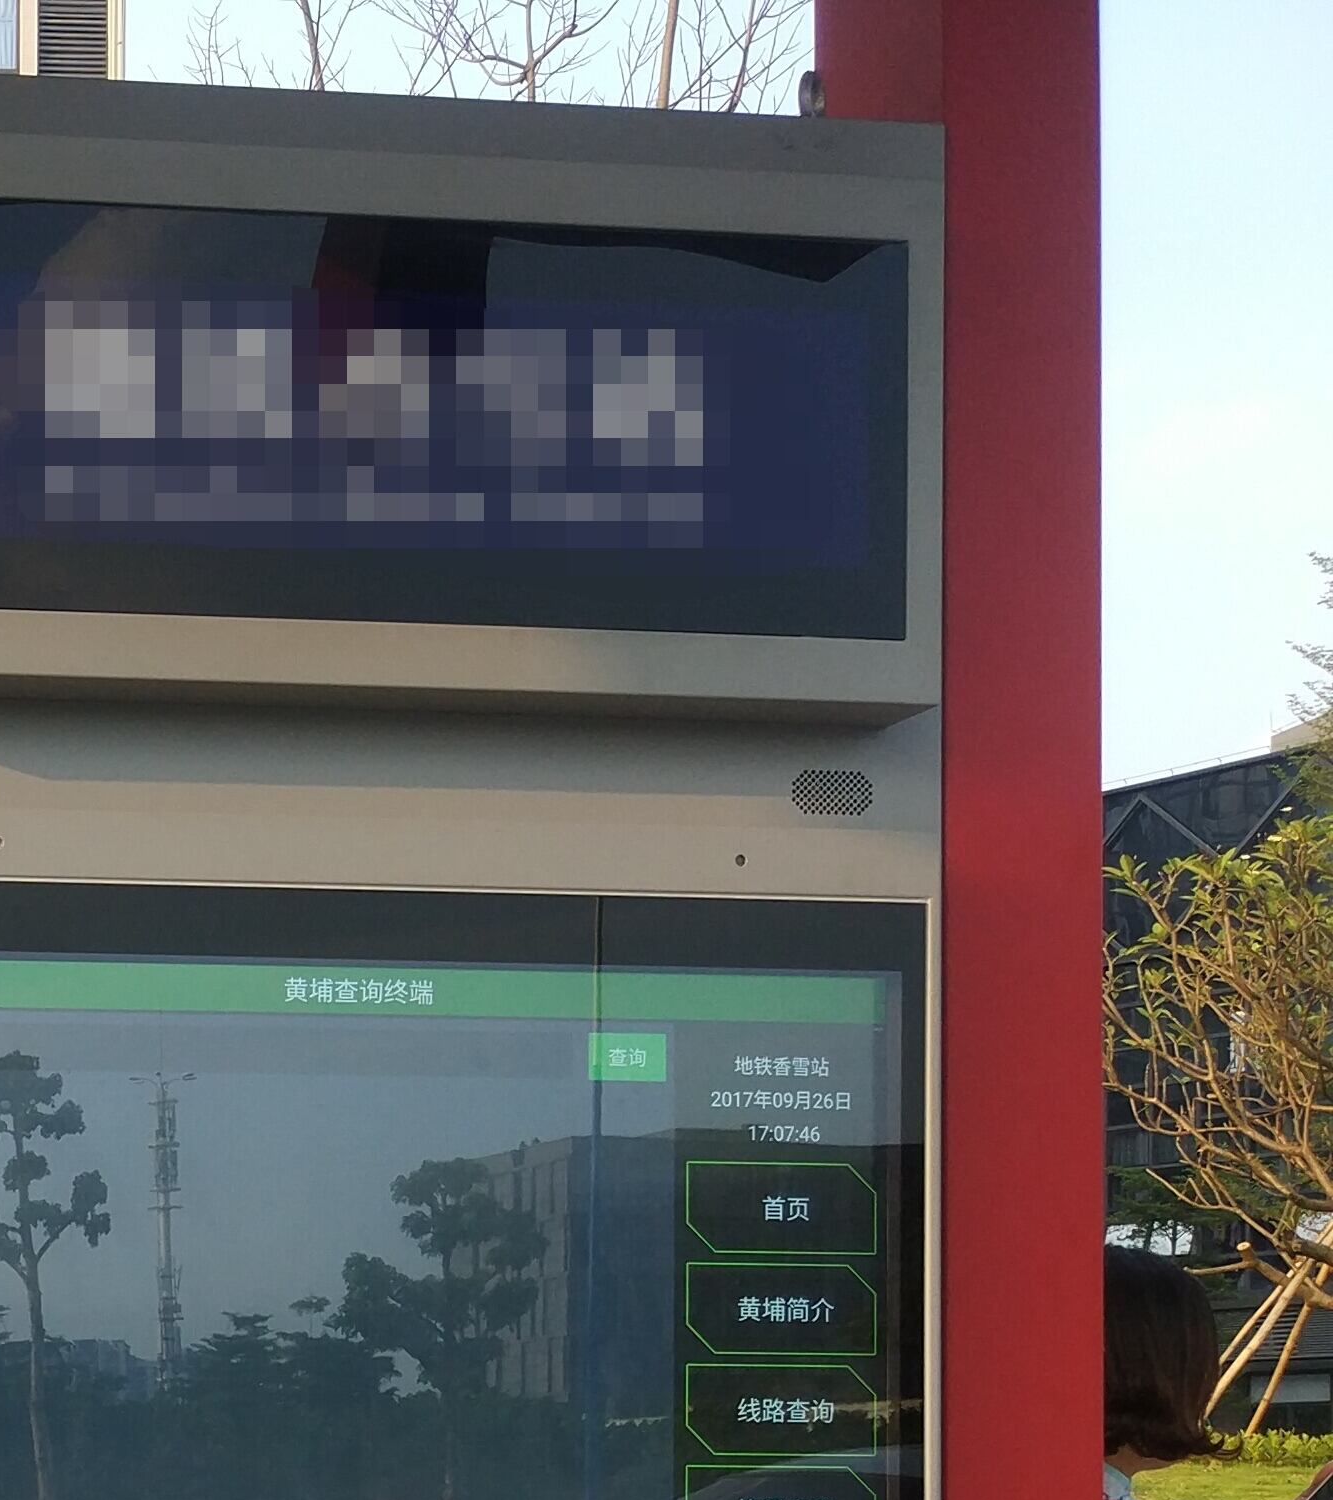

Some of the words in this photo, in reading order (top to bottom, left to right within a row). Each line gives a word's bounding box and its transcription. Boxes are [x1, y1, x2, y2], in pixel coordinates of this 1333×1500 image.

[284, 978, 434, 1005] 黄埔查询终端
[608, 1048, 647, 1067] 查询
[734, 1056, 830, 1077] 地铁香雪站
[710, 1090, 852, 1111] 2017年09月26日
[748, 1126, 821, 1143] 17:07:46
[761, 1196, 811, 1221] 首页
[737, 1296, 835, 1324] 黄埔简介
[737, 1397, 835, 1424] 线路查询
